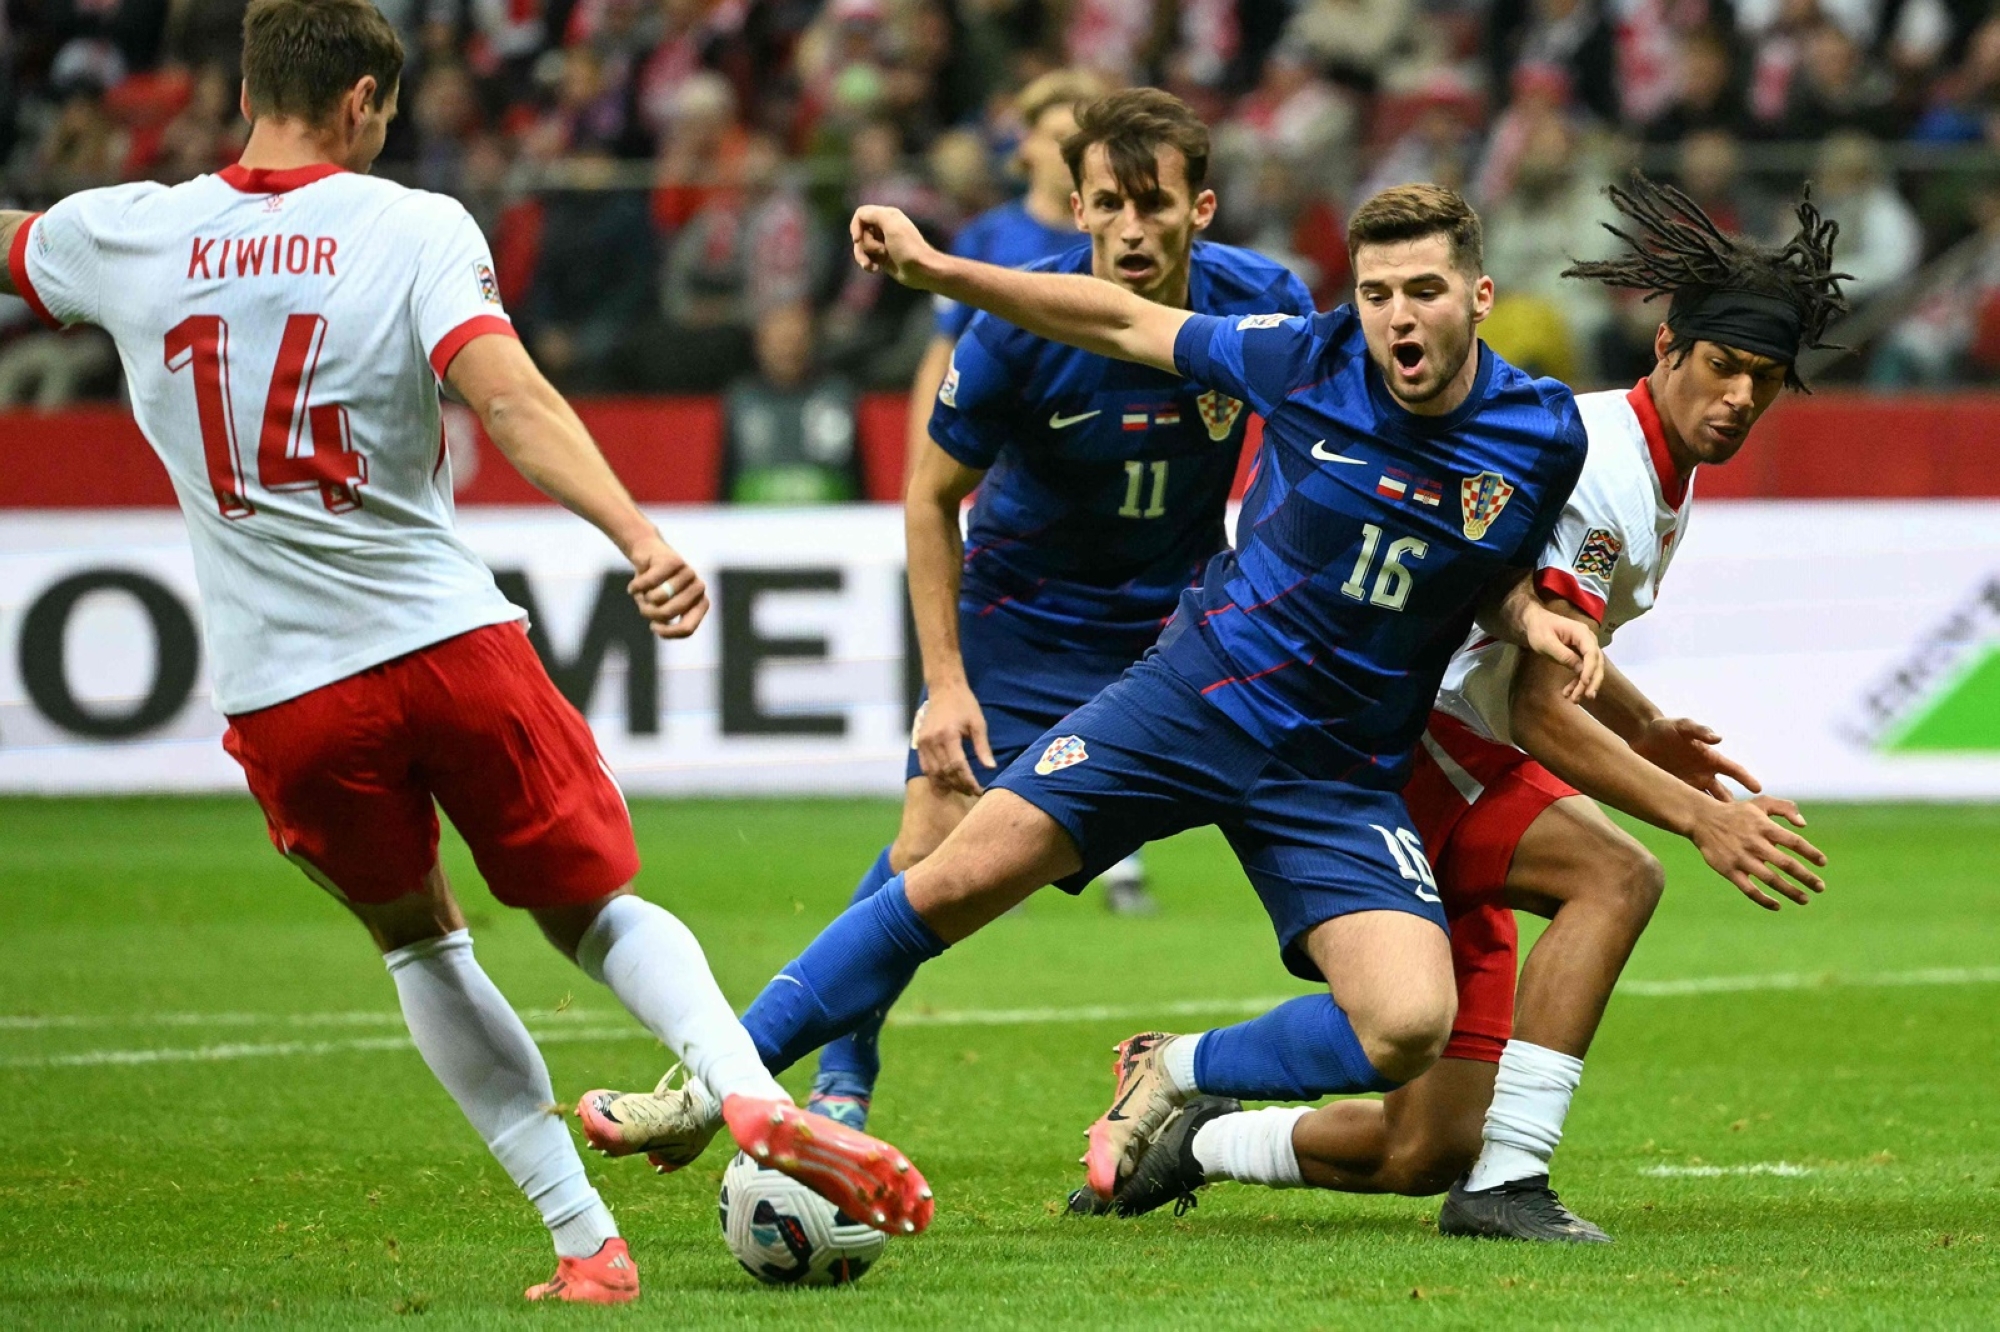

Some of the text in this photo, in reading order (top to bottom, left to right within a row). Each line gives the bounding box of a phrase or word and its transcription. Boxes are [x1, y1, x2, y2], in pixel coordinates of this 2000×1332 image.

[187, 233, 338, 279] KIWIOR
[163, 313, 369, 520] 14
[1118, 460, 1168, 518] 11
[1341, 523, 1429, 611] 16
[487, 566, 908, 738] ME
[1368, 825, 1439, 892] 16
